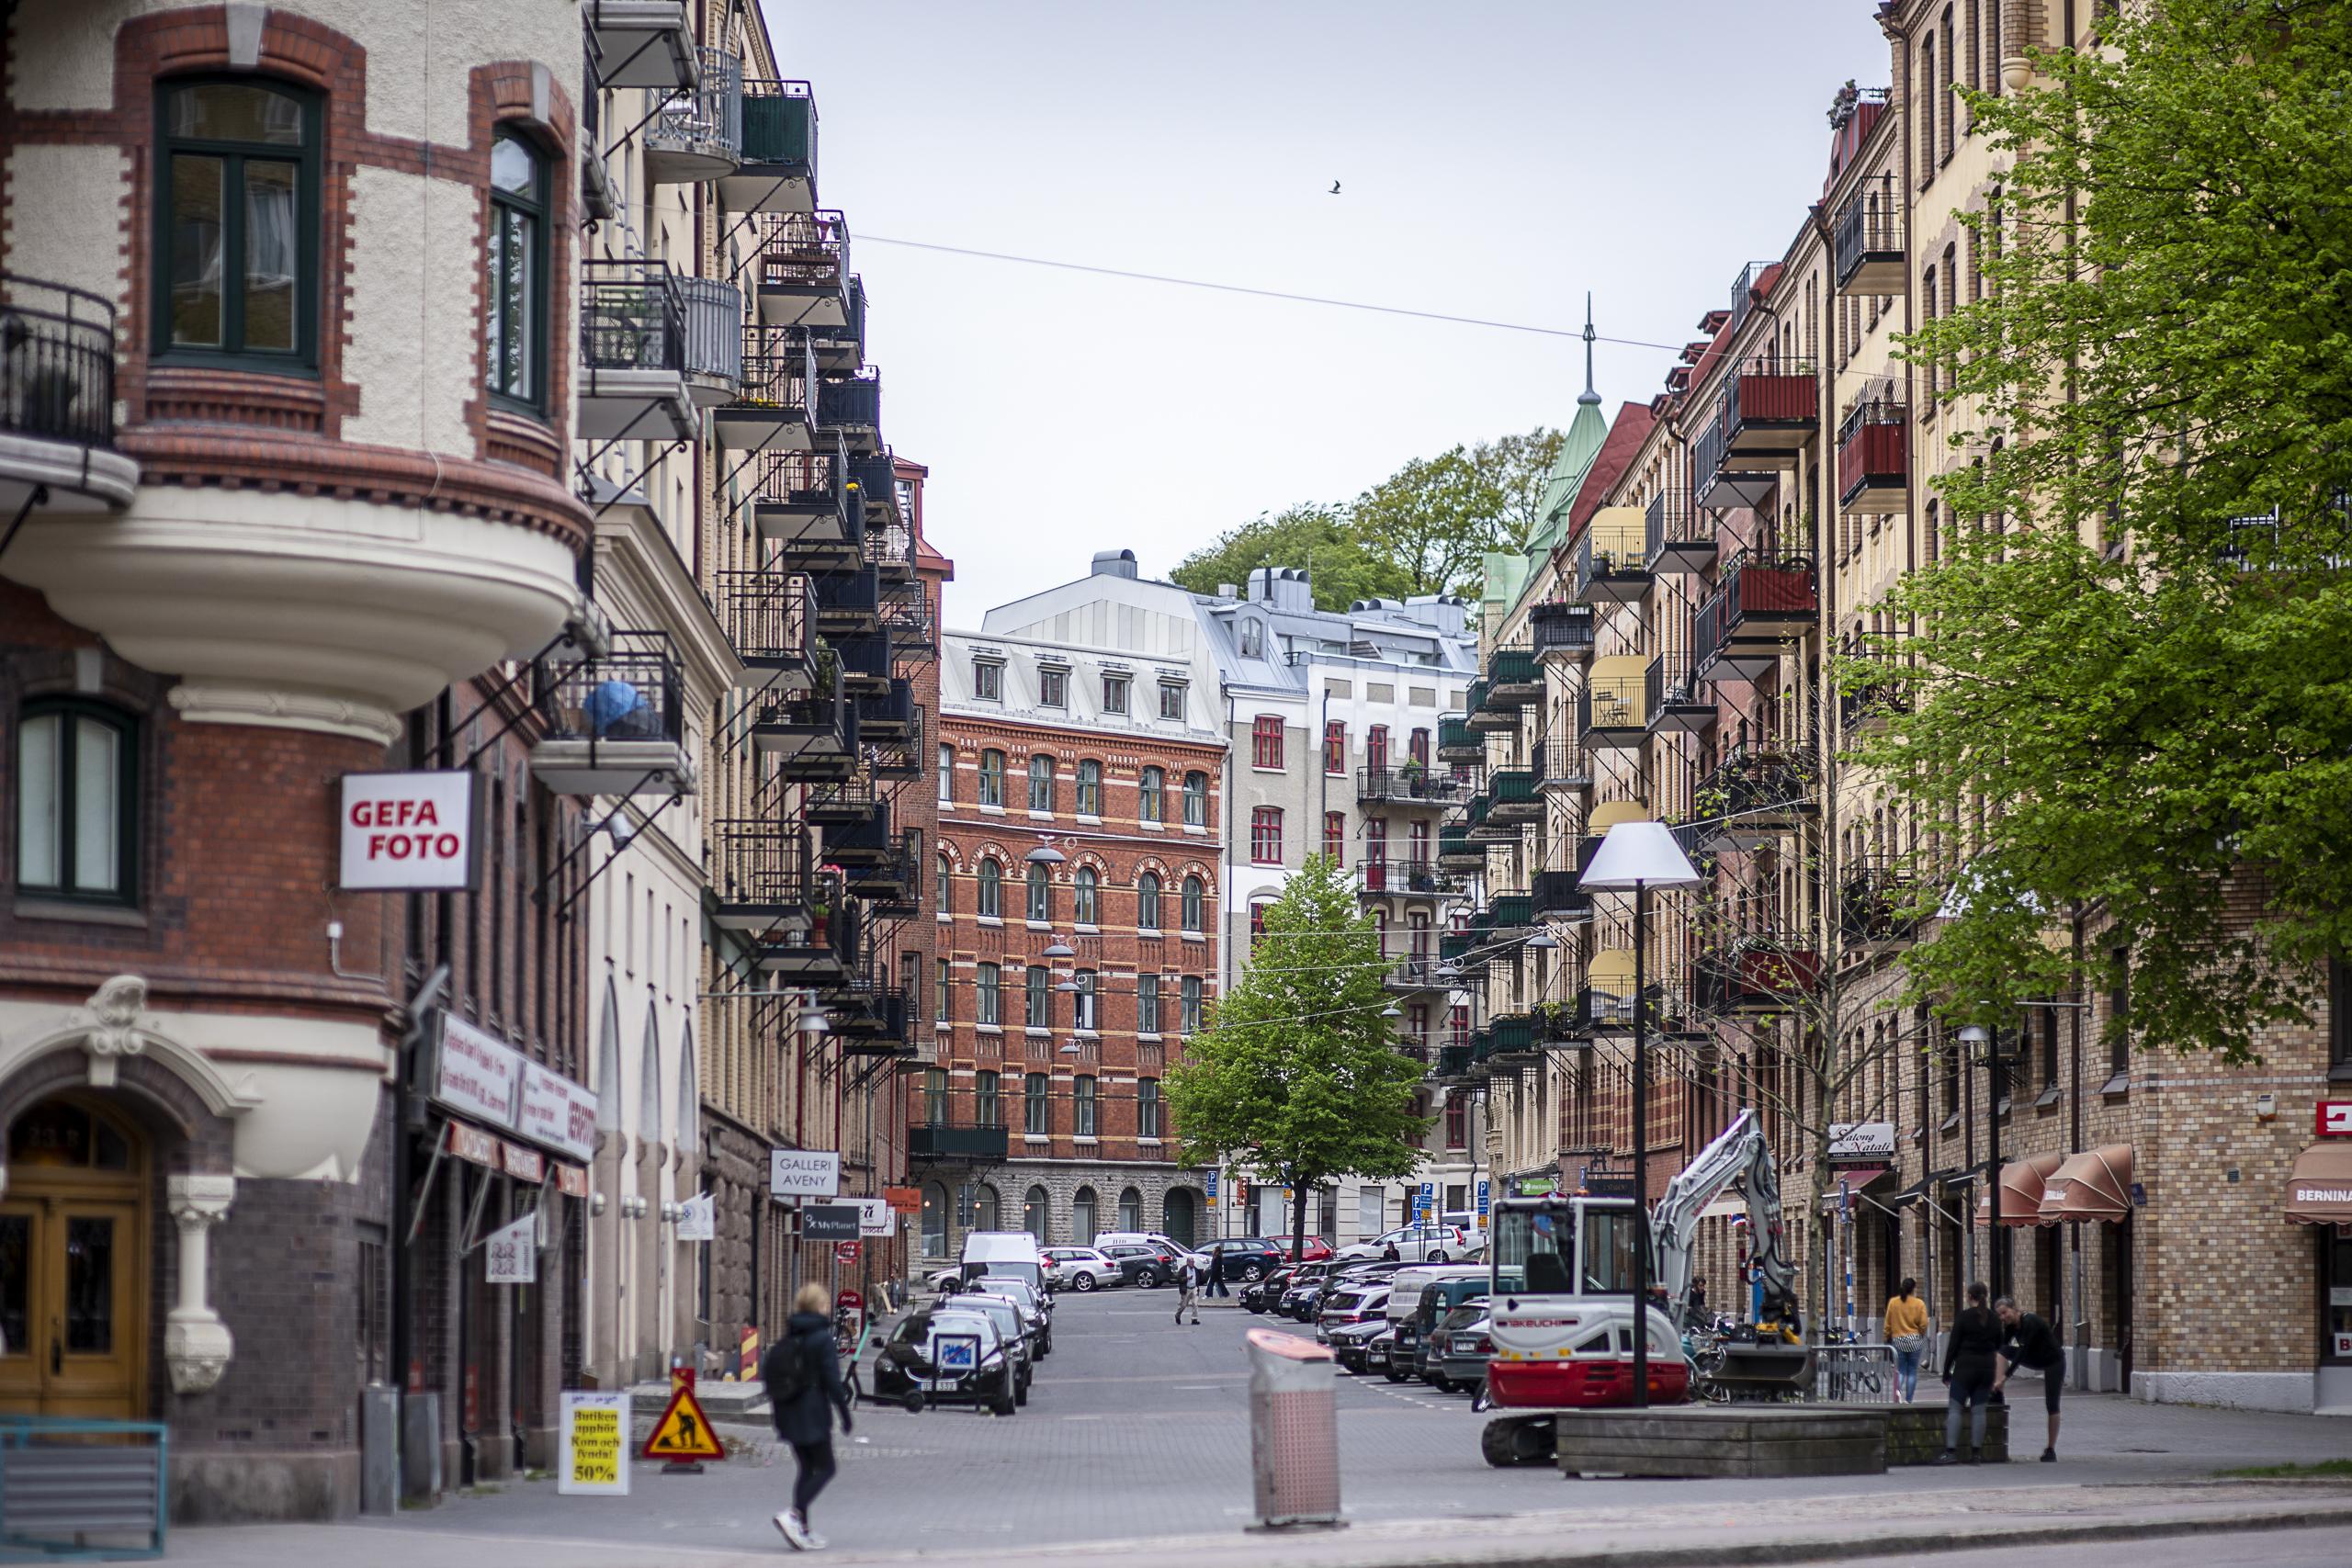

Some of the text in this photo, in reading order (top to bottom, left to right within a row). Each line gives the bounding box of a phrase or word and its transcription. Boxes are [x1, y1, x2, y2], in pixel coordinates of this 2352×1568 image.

[350, 800, 437, 828] GEFA
[368, 833, 459, 860] FOTO
[1851, 1142, 1891, 1153] Natali
[779, 1158, 831, 1171] GALLERI
[783, 1175, 827, 1187] AVENY
[573, 1410, 617, 1421] Butiken
[571, 1436, 620, 1447] Kom och
[574, 1465, 615, 1482] 50%
